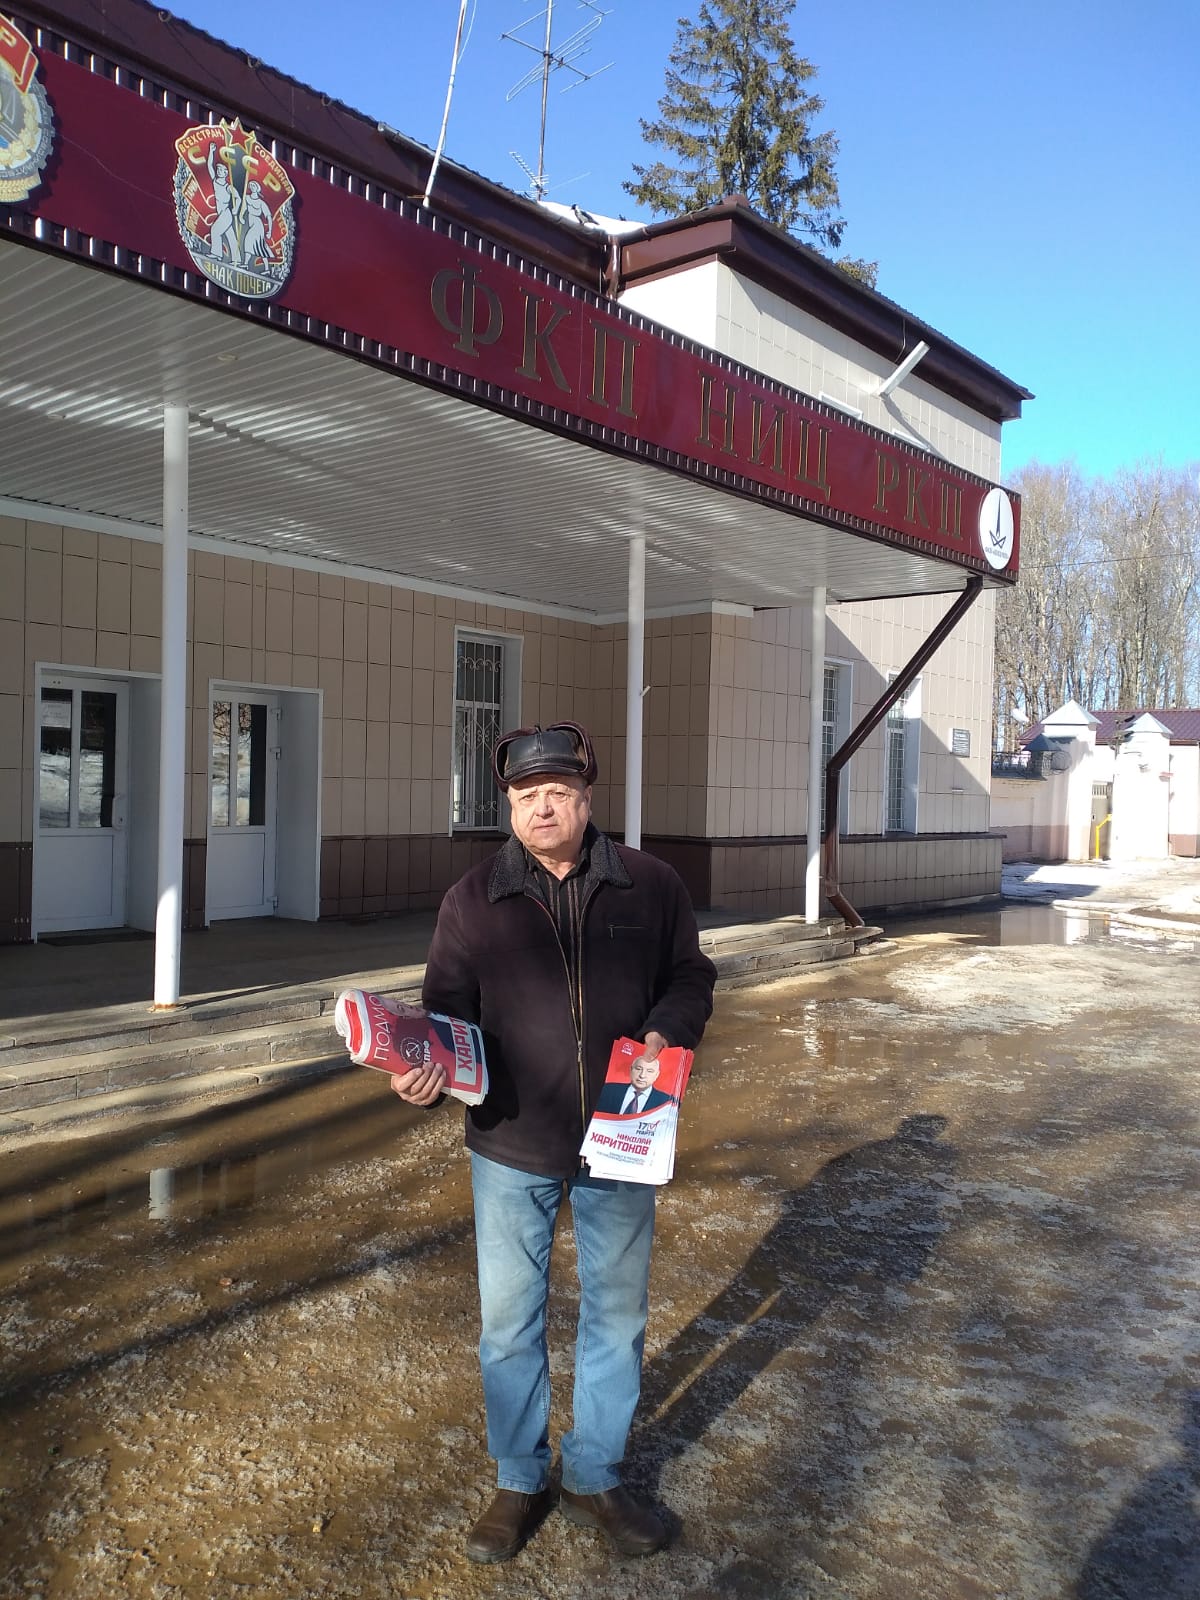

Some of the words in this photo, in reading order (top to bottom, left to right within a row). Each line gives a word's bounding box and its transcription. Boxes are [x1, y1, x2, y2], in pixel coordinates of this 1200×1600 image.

[203, 261, 234, 289] ЗНАК
[236, 272, 271, 294] ПОЧЕТА
[430, 257, 641, 420] ФКП
[695, 369, 833, 502] НИЦ
[872, 448, 966, 541] РКП
[590, 1132, 650, 1156] ХАРИТОНОВ
